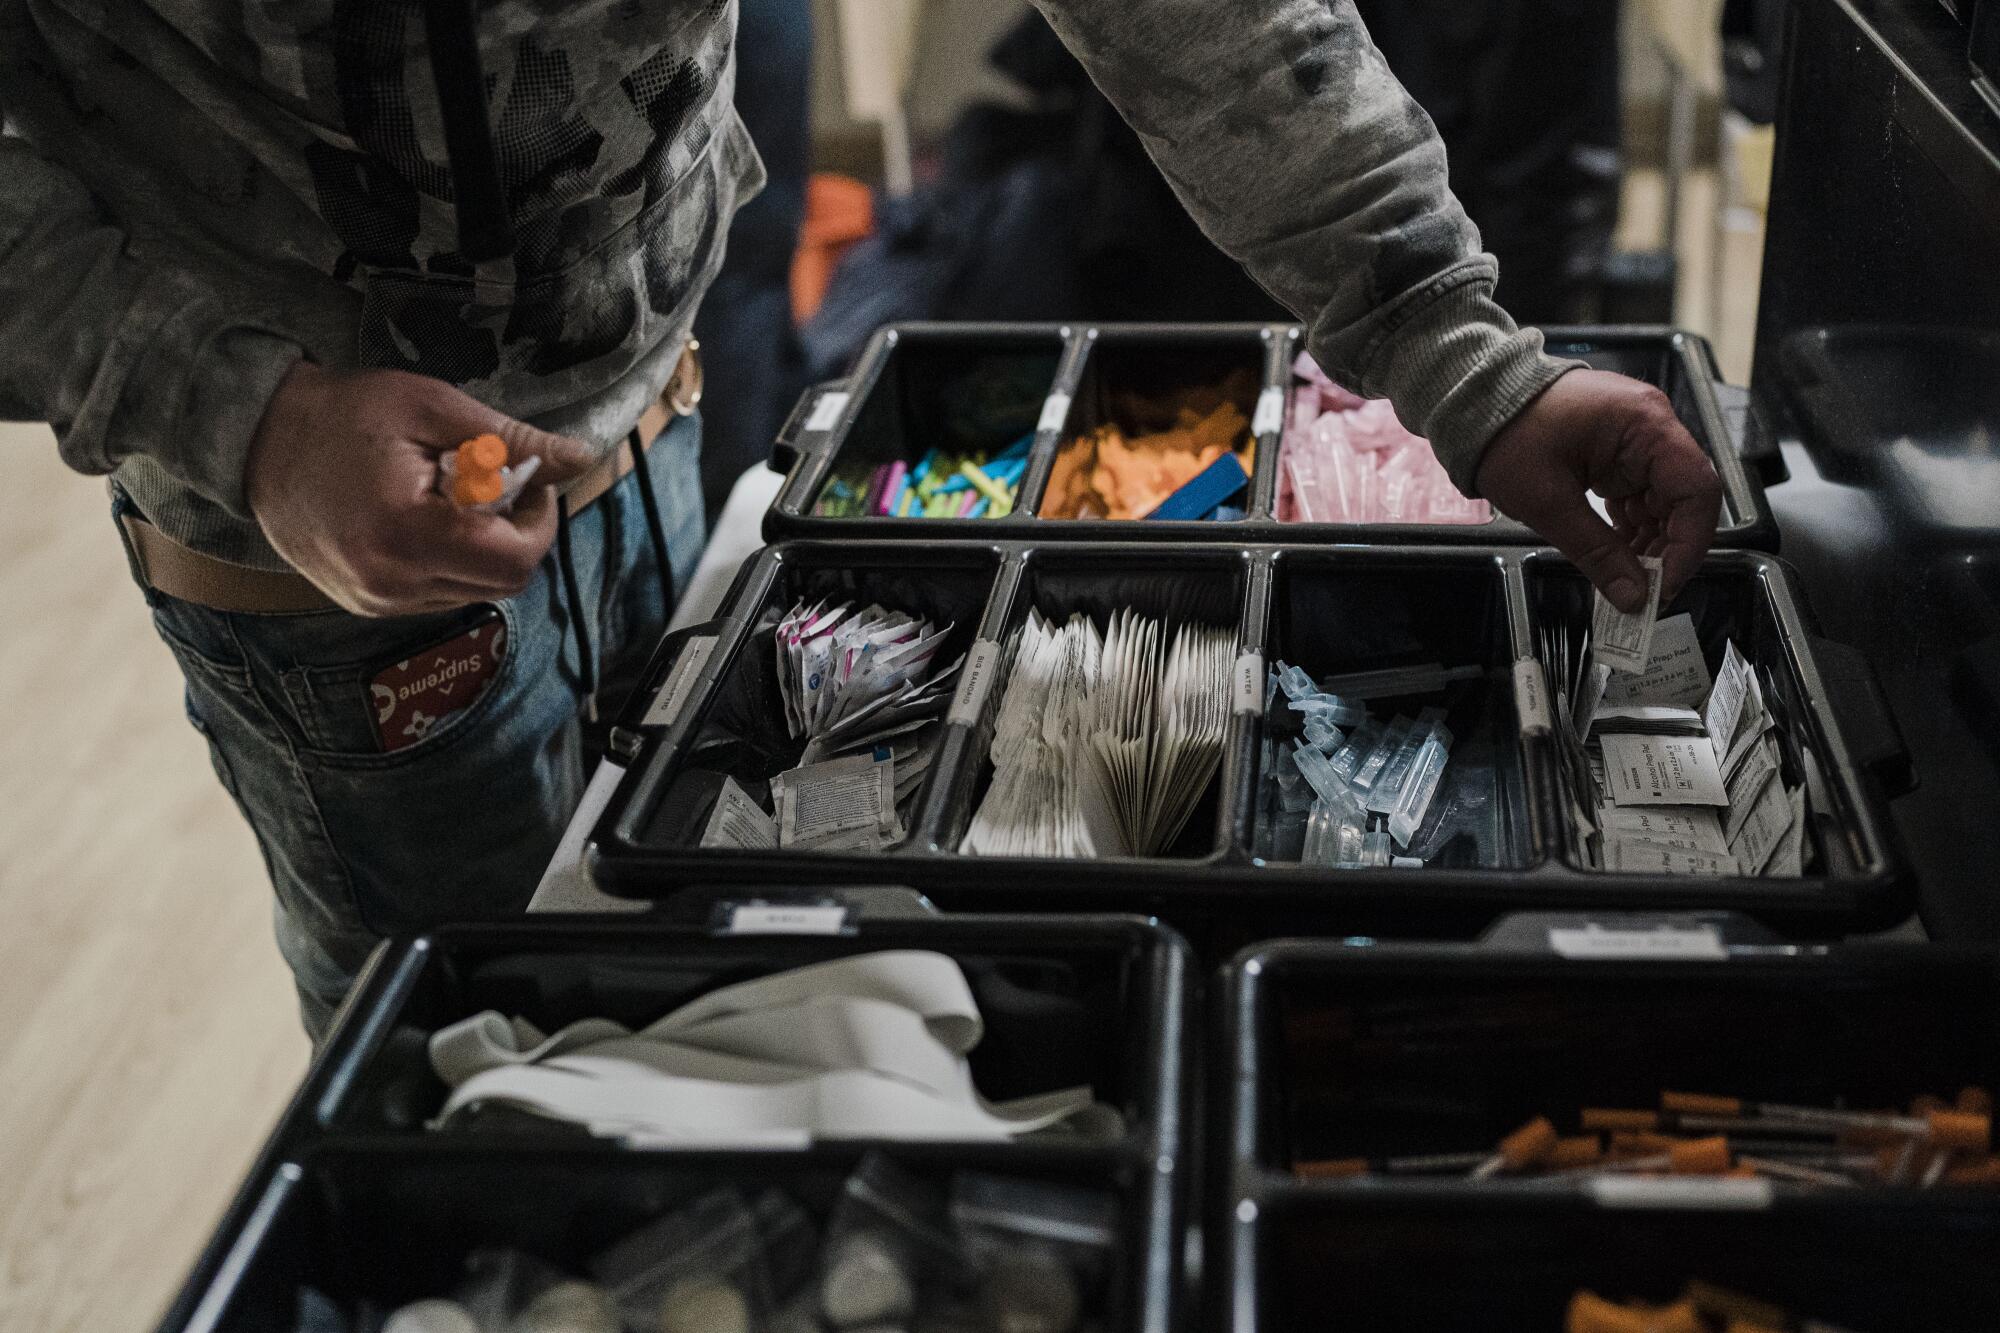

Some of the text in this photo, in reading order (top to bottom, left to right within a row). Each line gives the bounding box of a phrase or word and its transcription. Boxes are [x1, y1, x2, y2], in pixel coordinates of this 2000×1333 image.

[974, 655, 984, 669] BIG
[399, 654, 481, 700] Supreme
[1243, 667, 1251, 694] WATER
[1647, 767, 1659, 788] Alcohol
